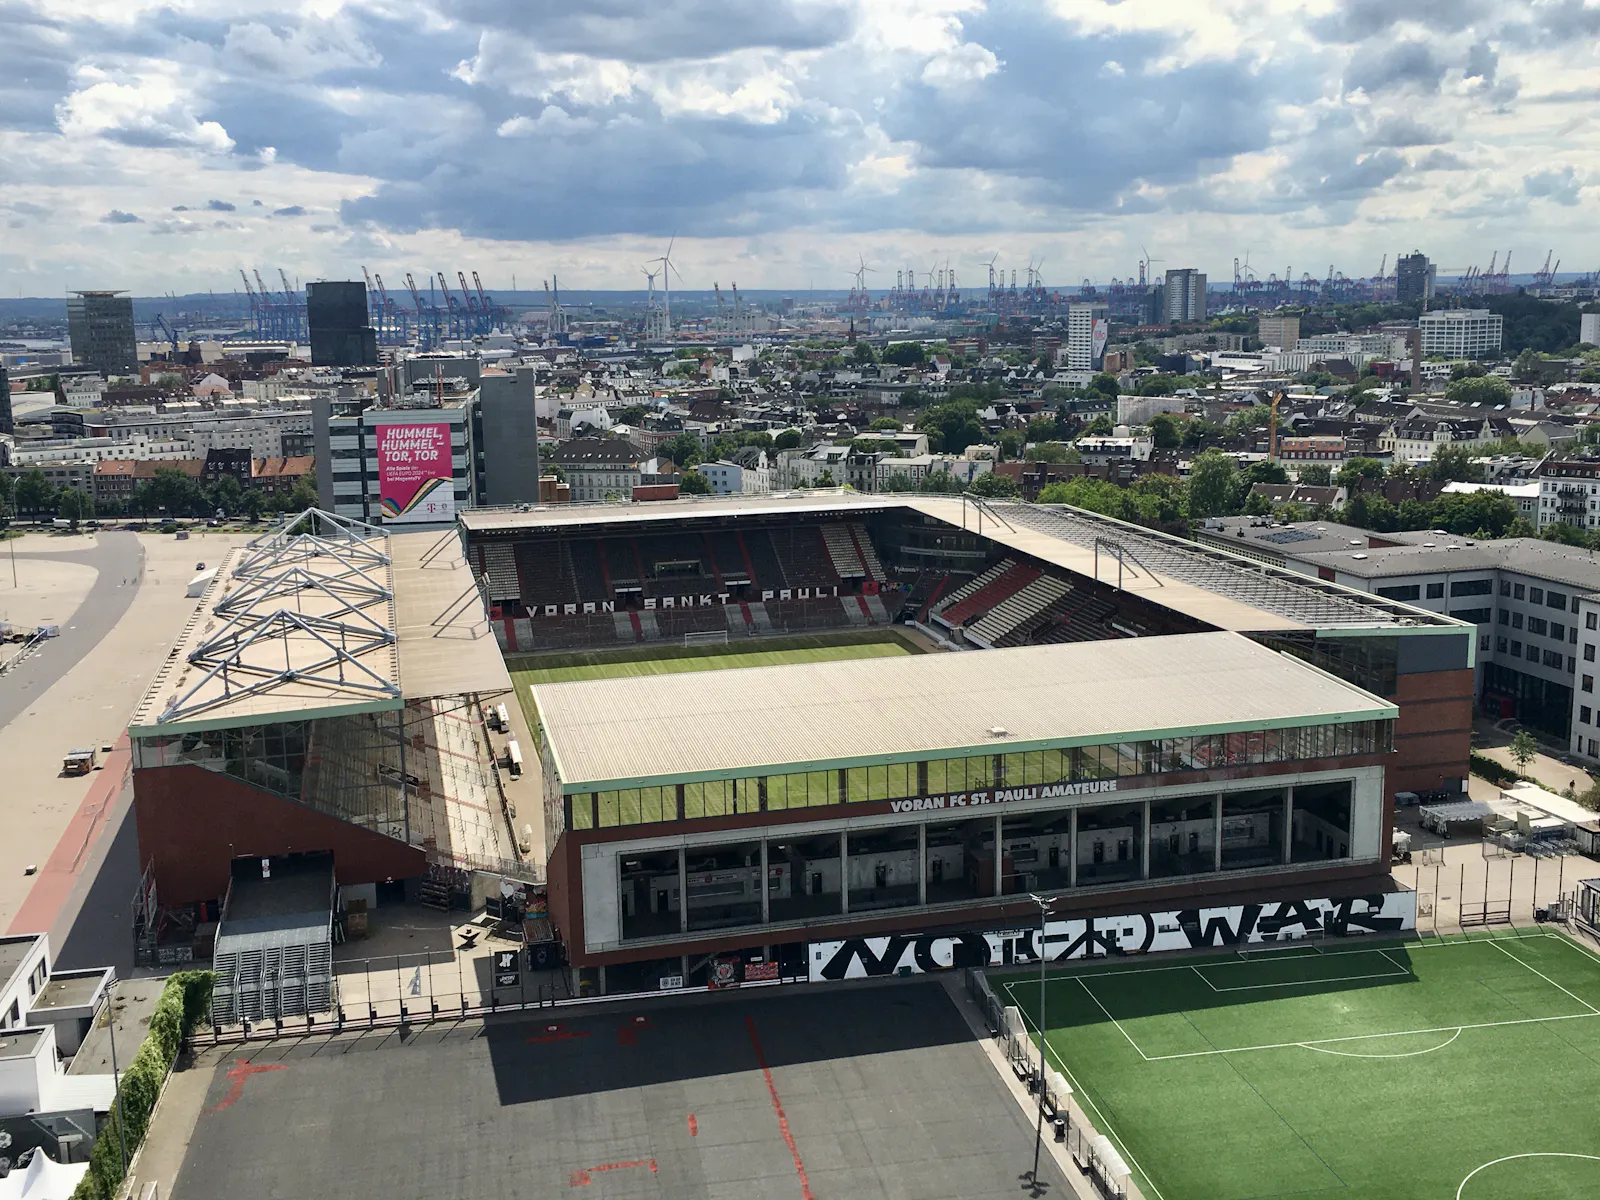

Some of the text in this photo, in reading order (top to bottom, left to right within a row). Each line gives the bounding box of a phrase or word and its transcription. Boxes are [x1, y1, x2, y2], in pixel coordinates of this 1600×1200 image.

[386, 427, 443, 440] HUMMEL,
[381, 439, 434, 451] HUMMEL
[384, 450, 439, 464] TOR, TOR
[526, 586, 838, 618] VORAN SANKT PAULI
[890, 780, 1118, 813] VORAN FC ST. PAULI AMATEURE
